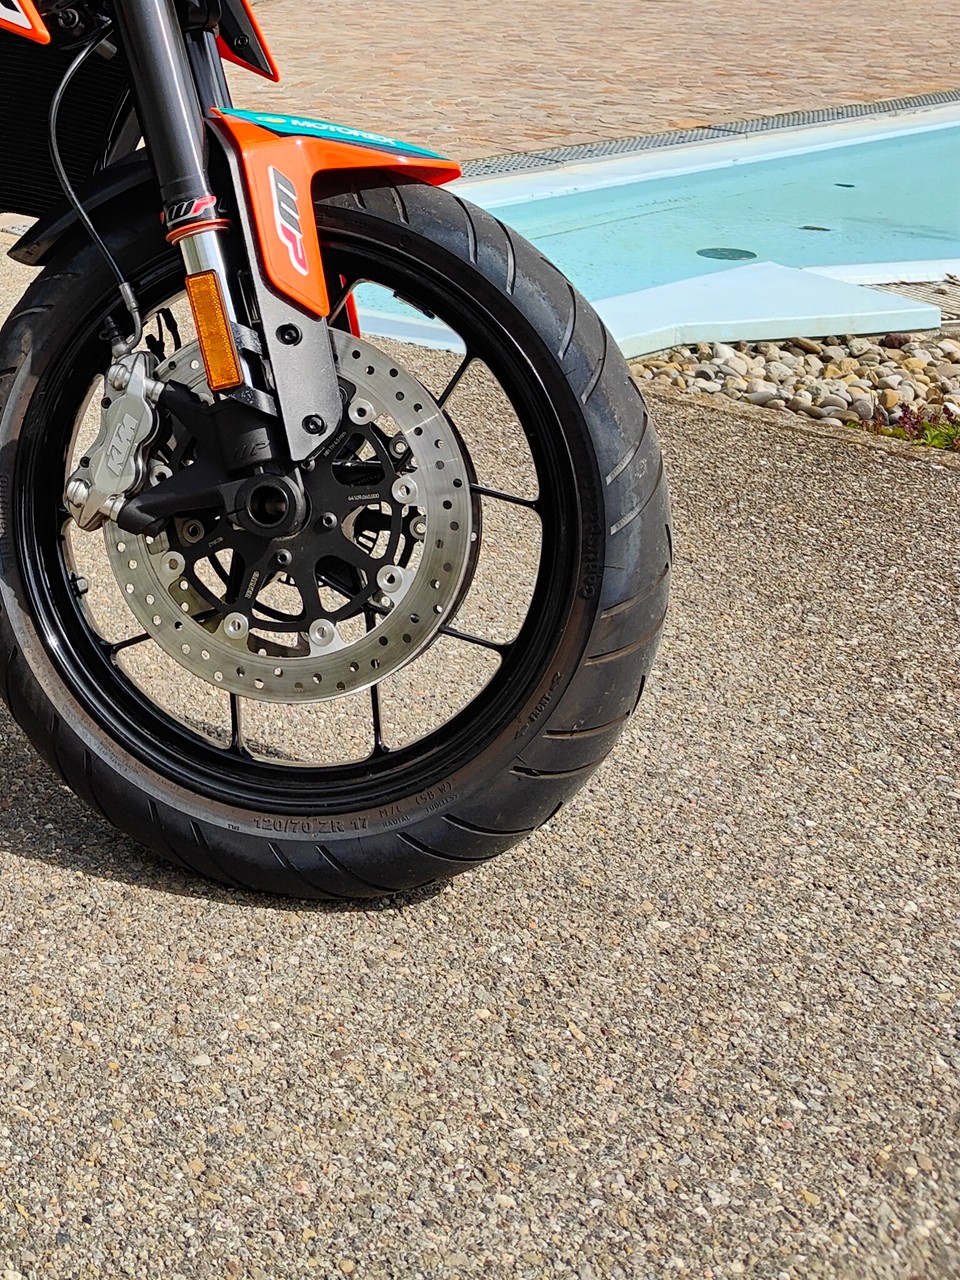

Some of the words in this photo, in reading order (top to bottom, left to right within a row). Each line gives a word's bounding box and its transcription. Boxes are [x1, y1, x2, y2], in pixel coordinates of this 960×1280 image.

[290, 119, 398, 146] MOTOREX
[107, 413, 139, 477] KTM
[253, 816, 311, 834] 120/70
[316, 820, 345, 834] ZR
[350, 816, 370, 831] 17
